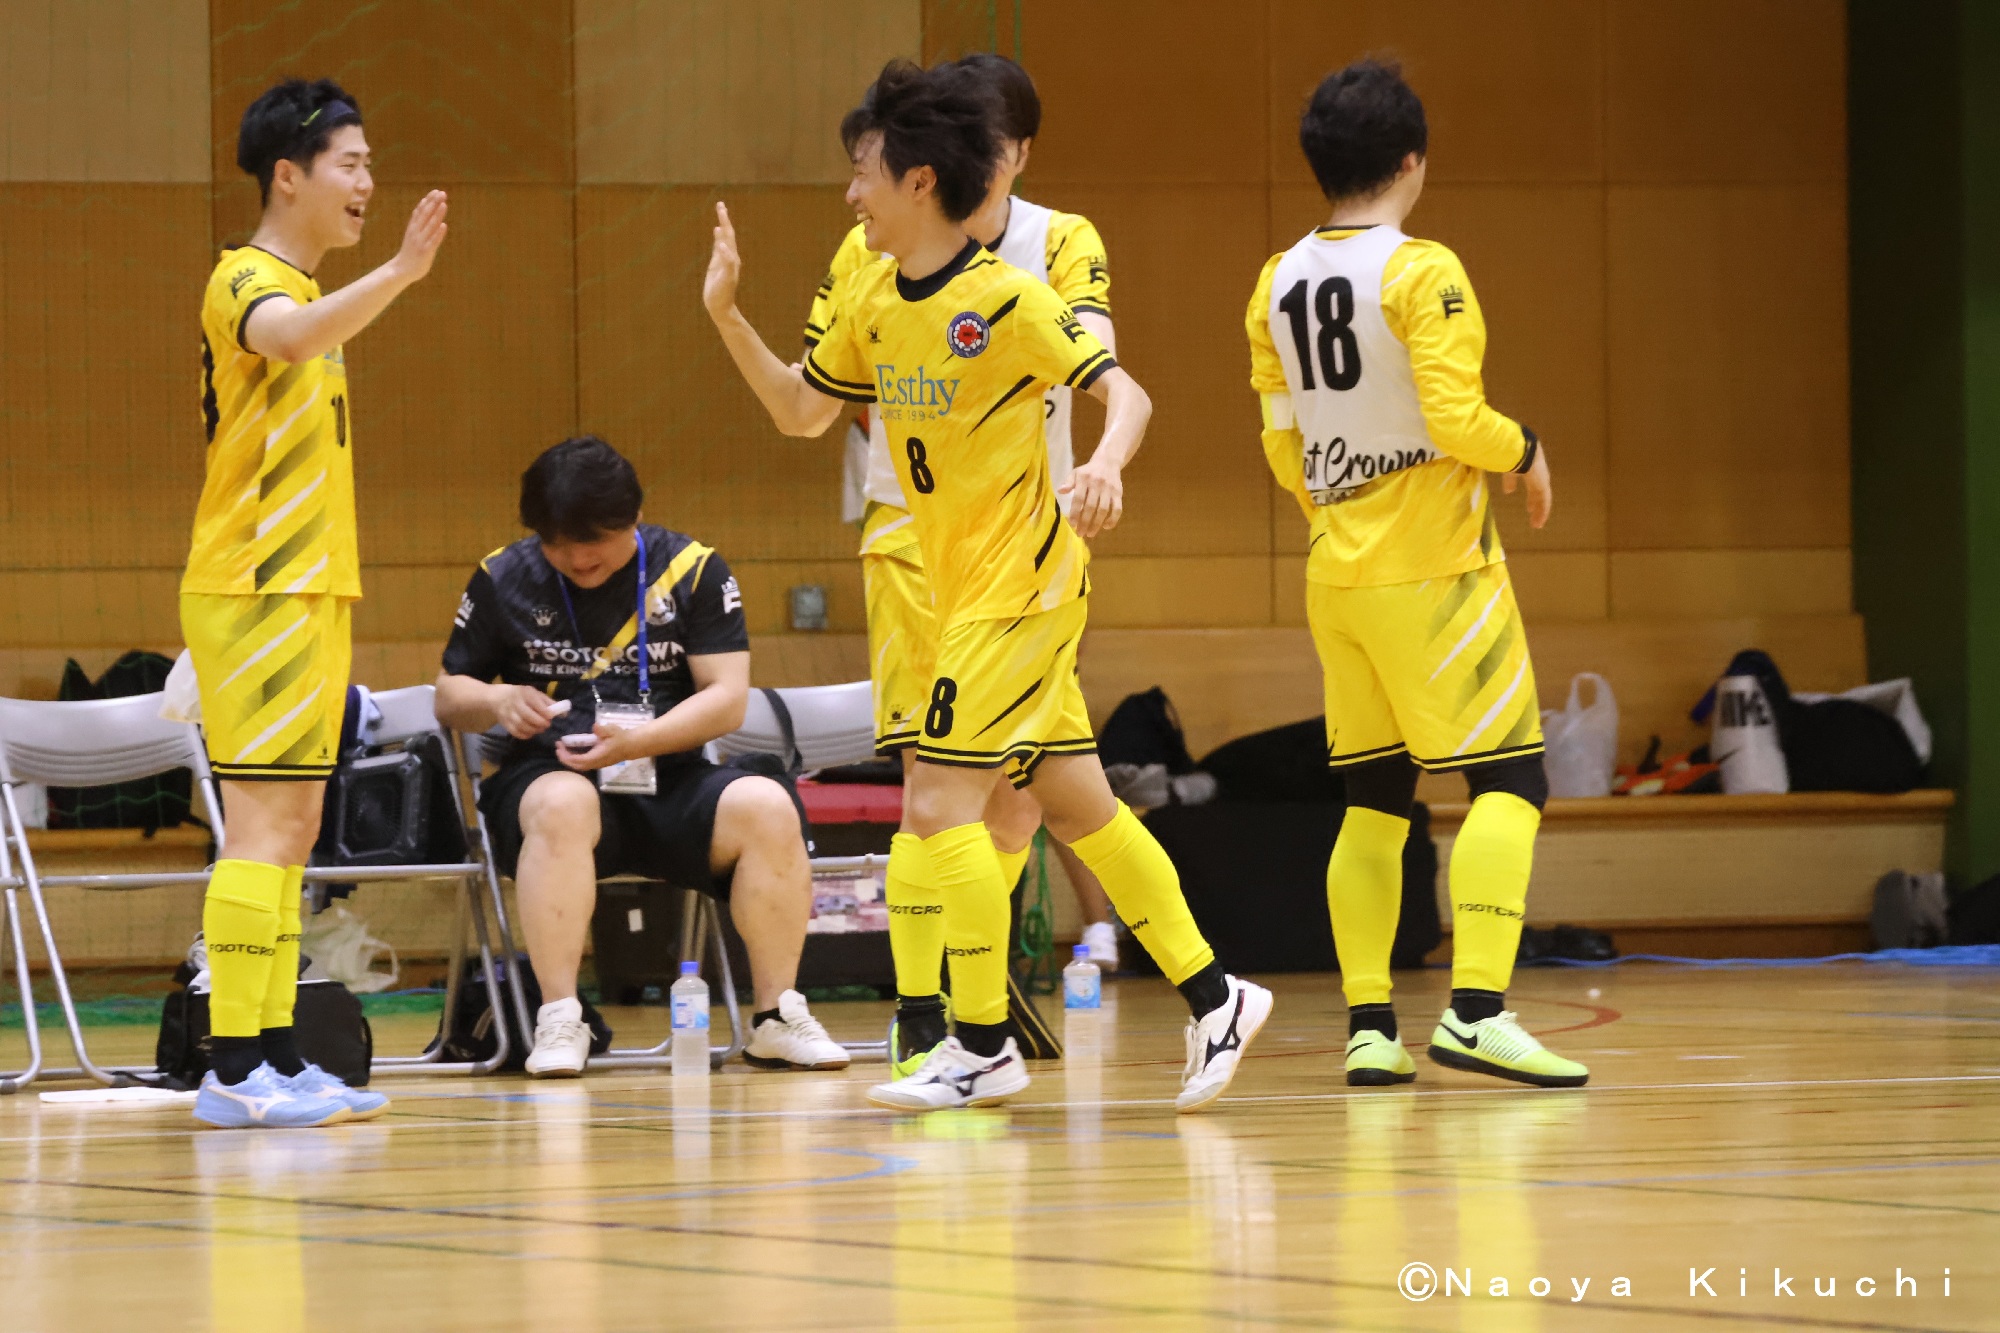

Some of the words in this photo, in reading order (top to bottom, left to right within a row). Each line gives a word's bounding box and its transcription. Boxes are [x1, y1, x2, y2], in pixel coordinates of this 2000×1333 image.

[1279, 276, 1362, 392] 18
[875, 364, 960, 416] Esthy
[906, 437, 935, 494] 8
[529, 662, 553, 674] THE
[924, 676, 958, 739] 8
[208, 943, 276, 957] FOOTCRO
